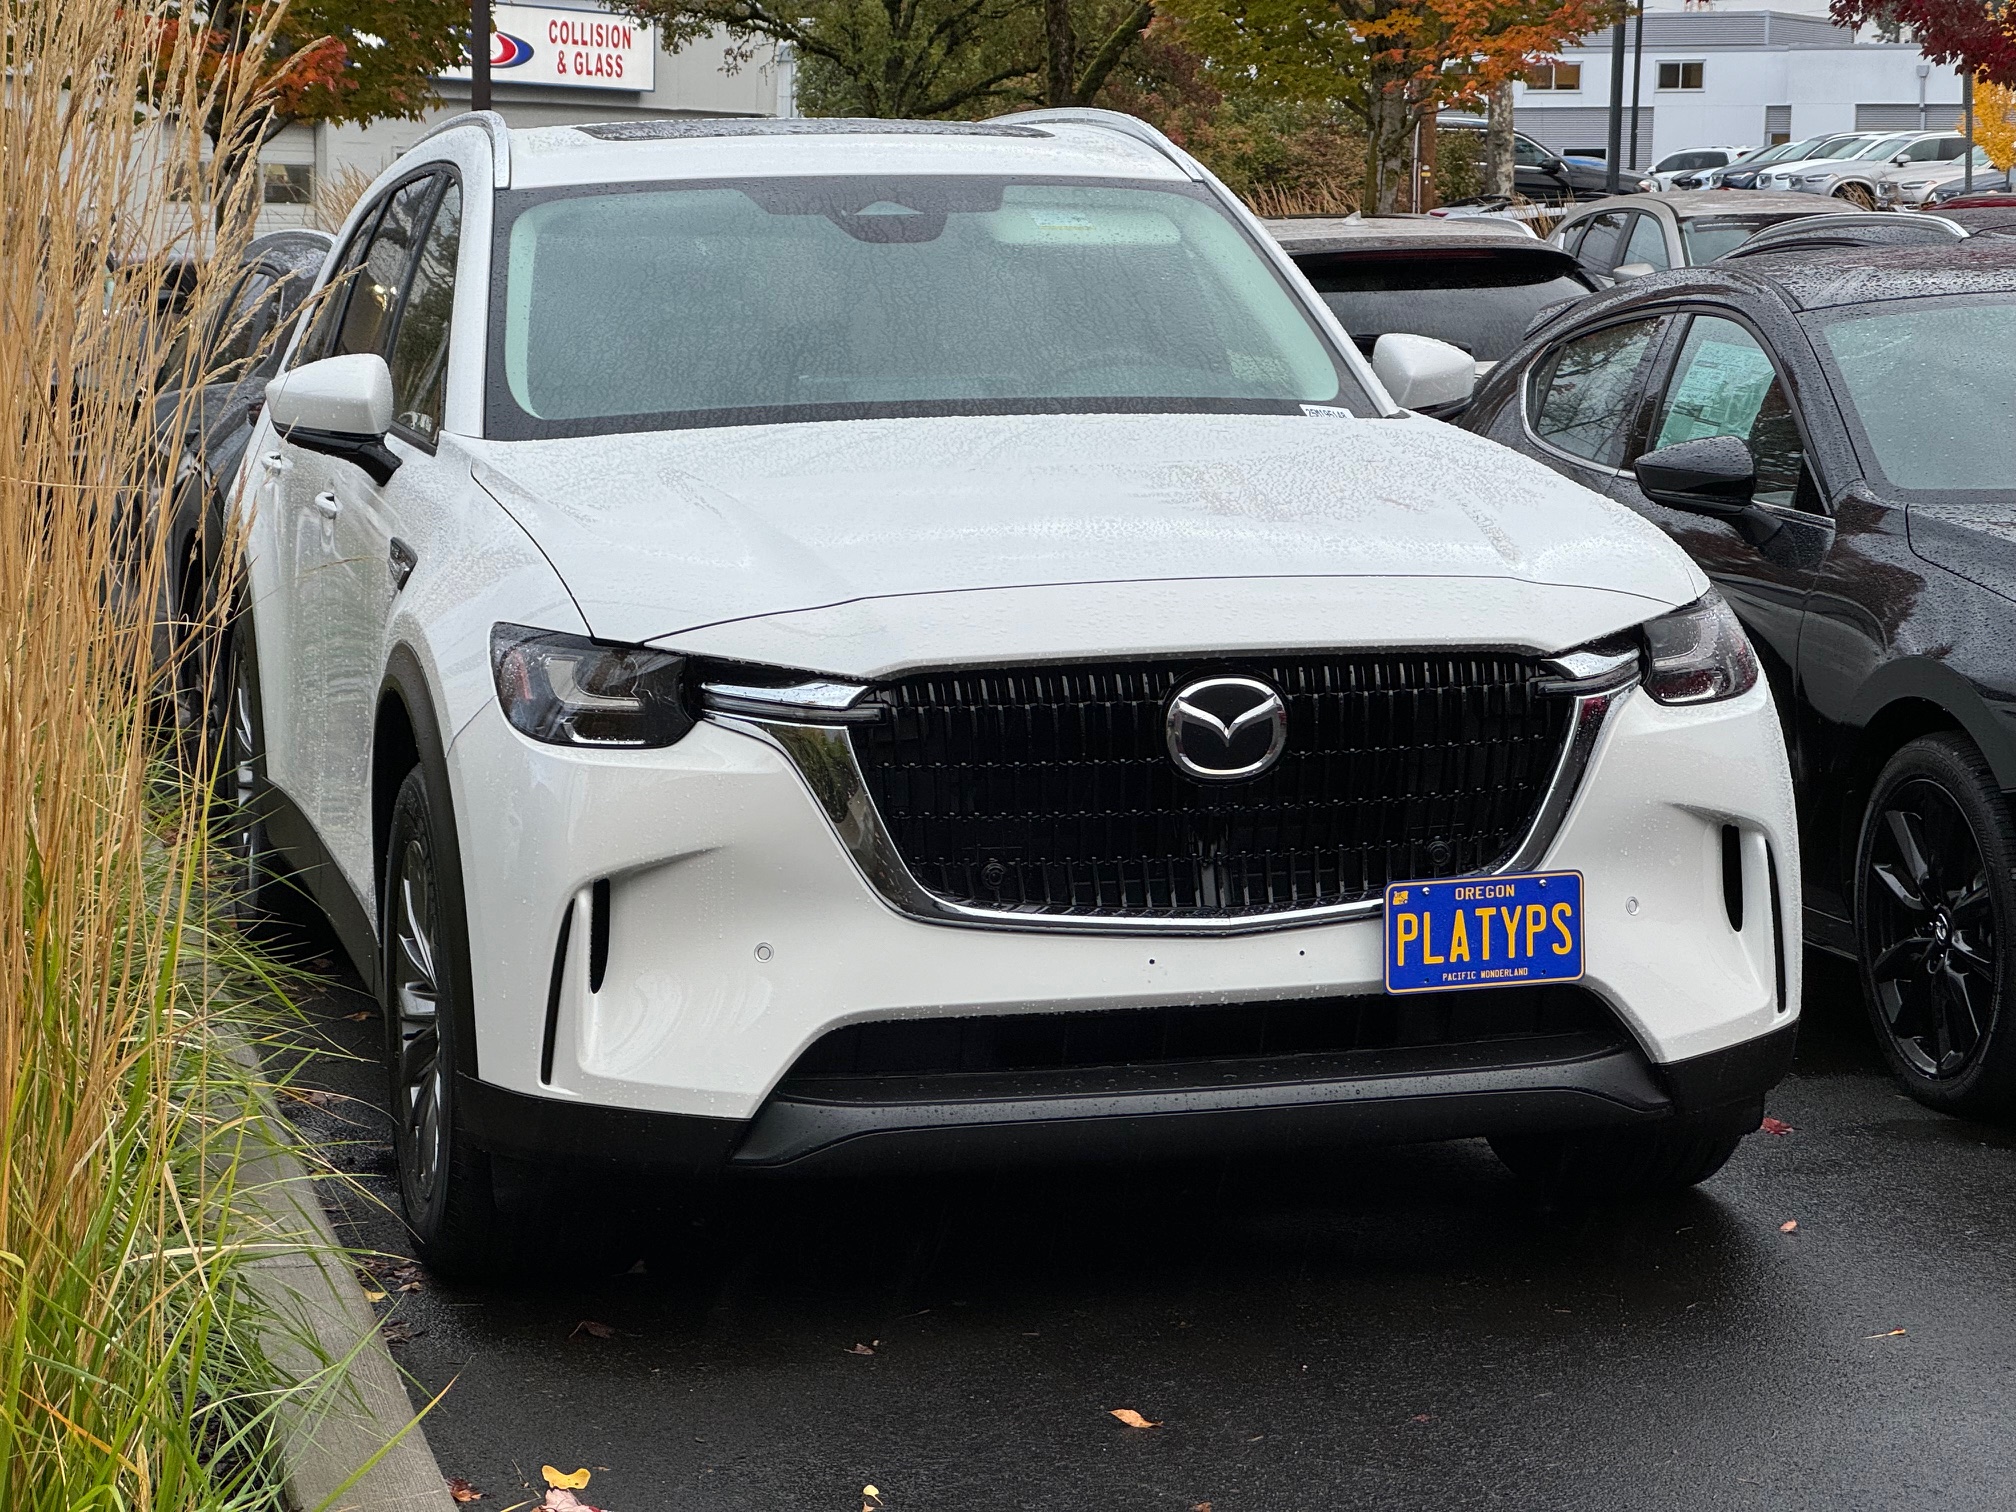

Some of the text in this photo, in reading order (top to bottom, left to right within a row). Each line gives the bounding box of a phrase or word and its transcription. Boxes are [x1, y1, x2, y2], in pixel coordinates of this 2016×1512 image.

[548, 19, 631, 49] COLLISION
[557, 50, 623, 78] & GLASS
[1455, 884, 1515, 900] OREGON
[1397, 902, 1573, 967] PLATYPS
[1442, 967, 1529, 982] PACIFIC WONDERLAND
